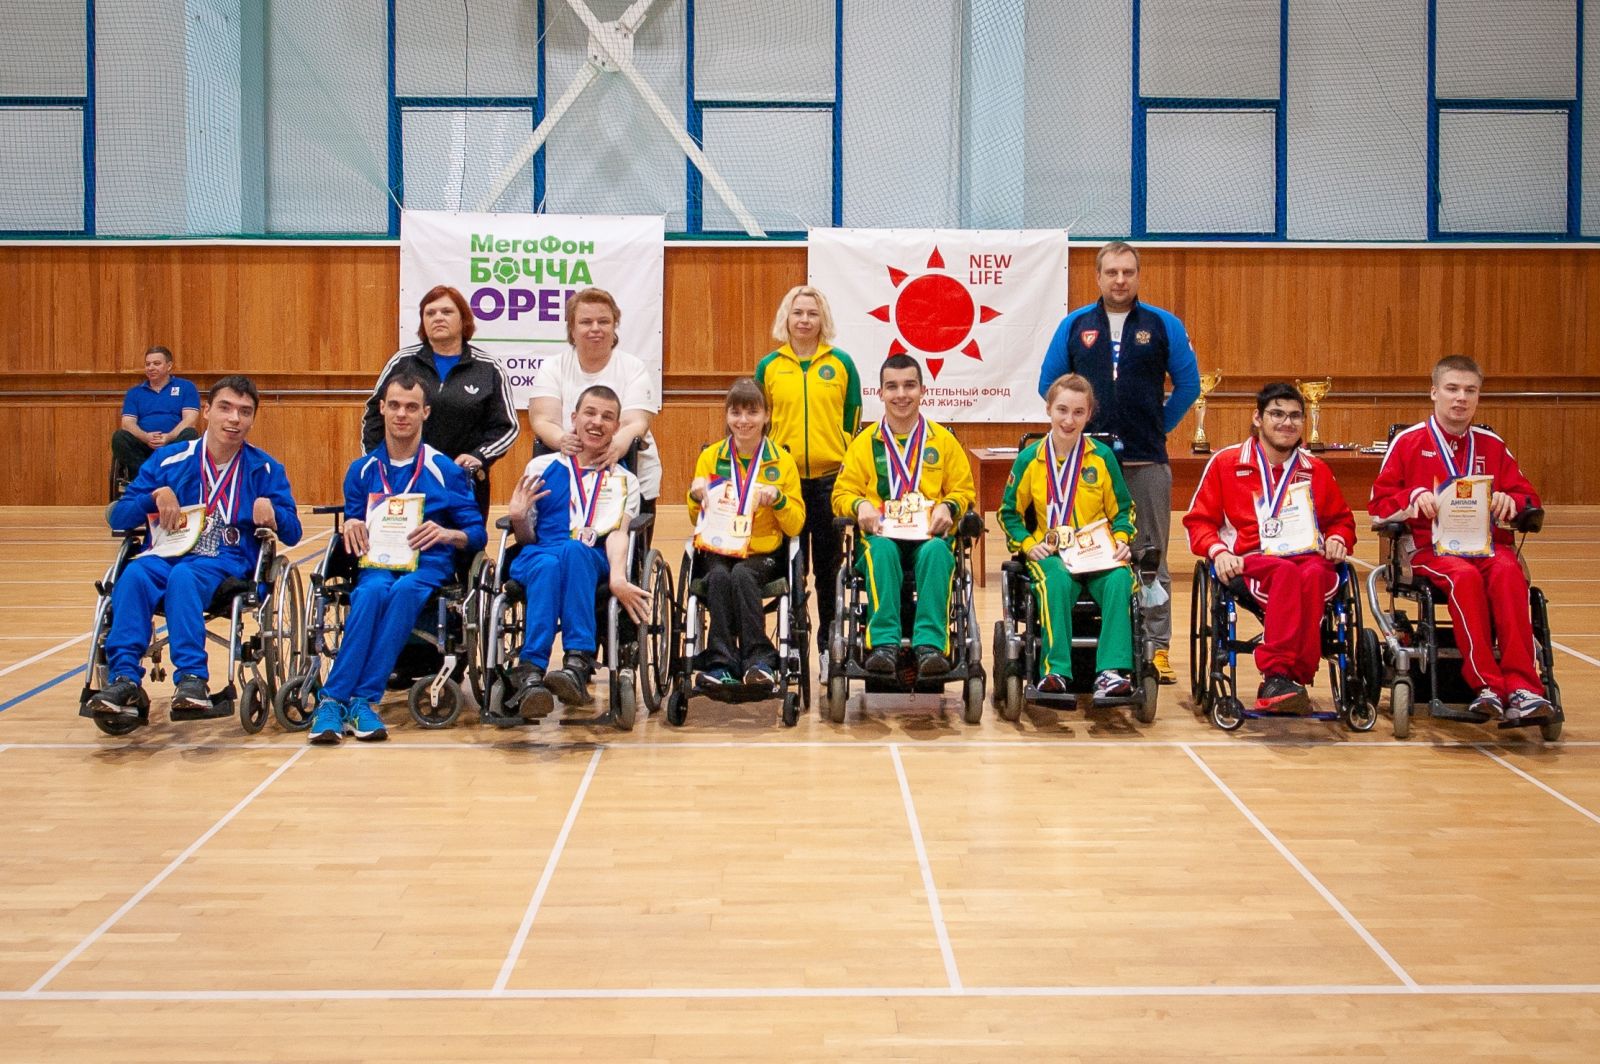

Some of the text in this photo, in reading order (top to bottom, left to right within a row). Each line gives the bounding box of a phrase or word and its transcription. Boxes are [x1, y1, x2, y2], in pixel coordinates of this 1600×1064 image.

[470, 233, 595, 254] МегаФон
[969, 254, 1012, 268] NEW
[470, 257, 593, 285] БОЧЧА
[969, 270, 1003, 285] LIFE
[507, 375, 536, 387] ОЖ
[981, 388, 1011, 397] ФОНД
